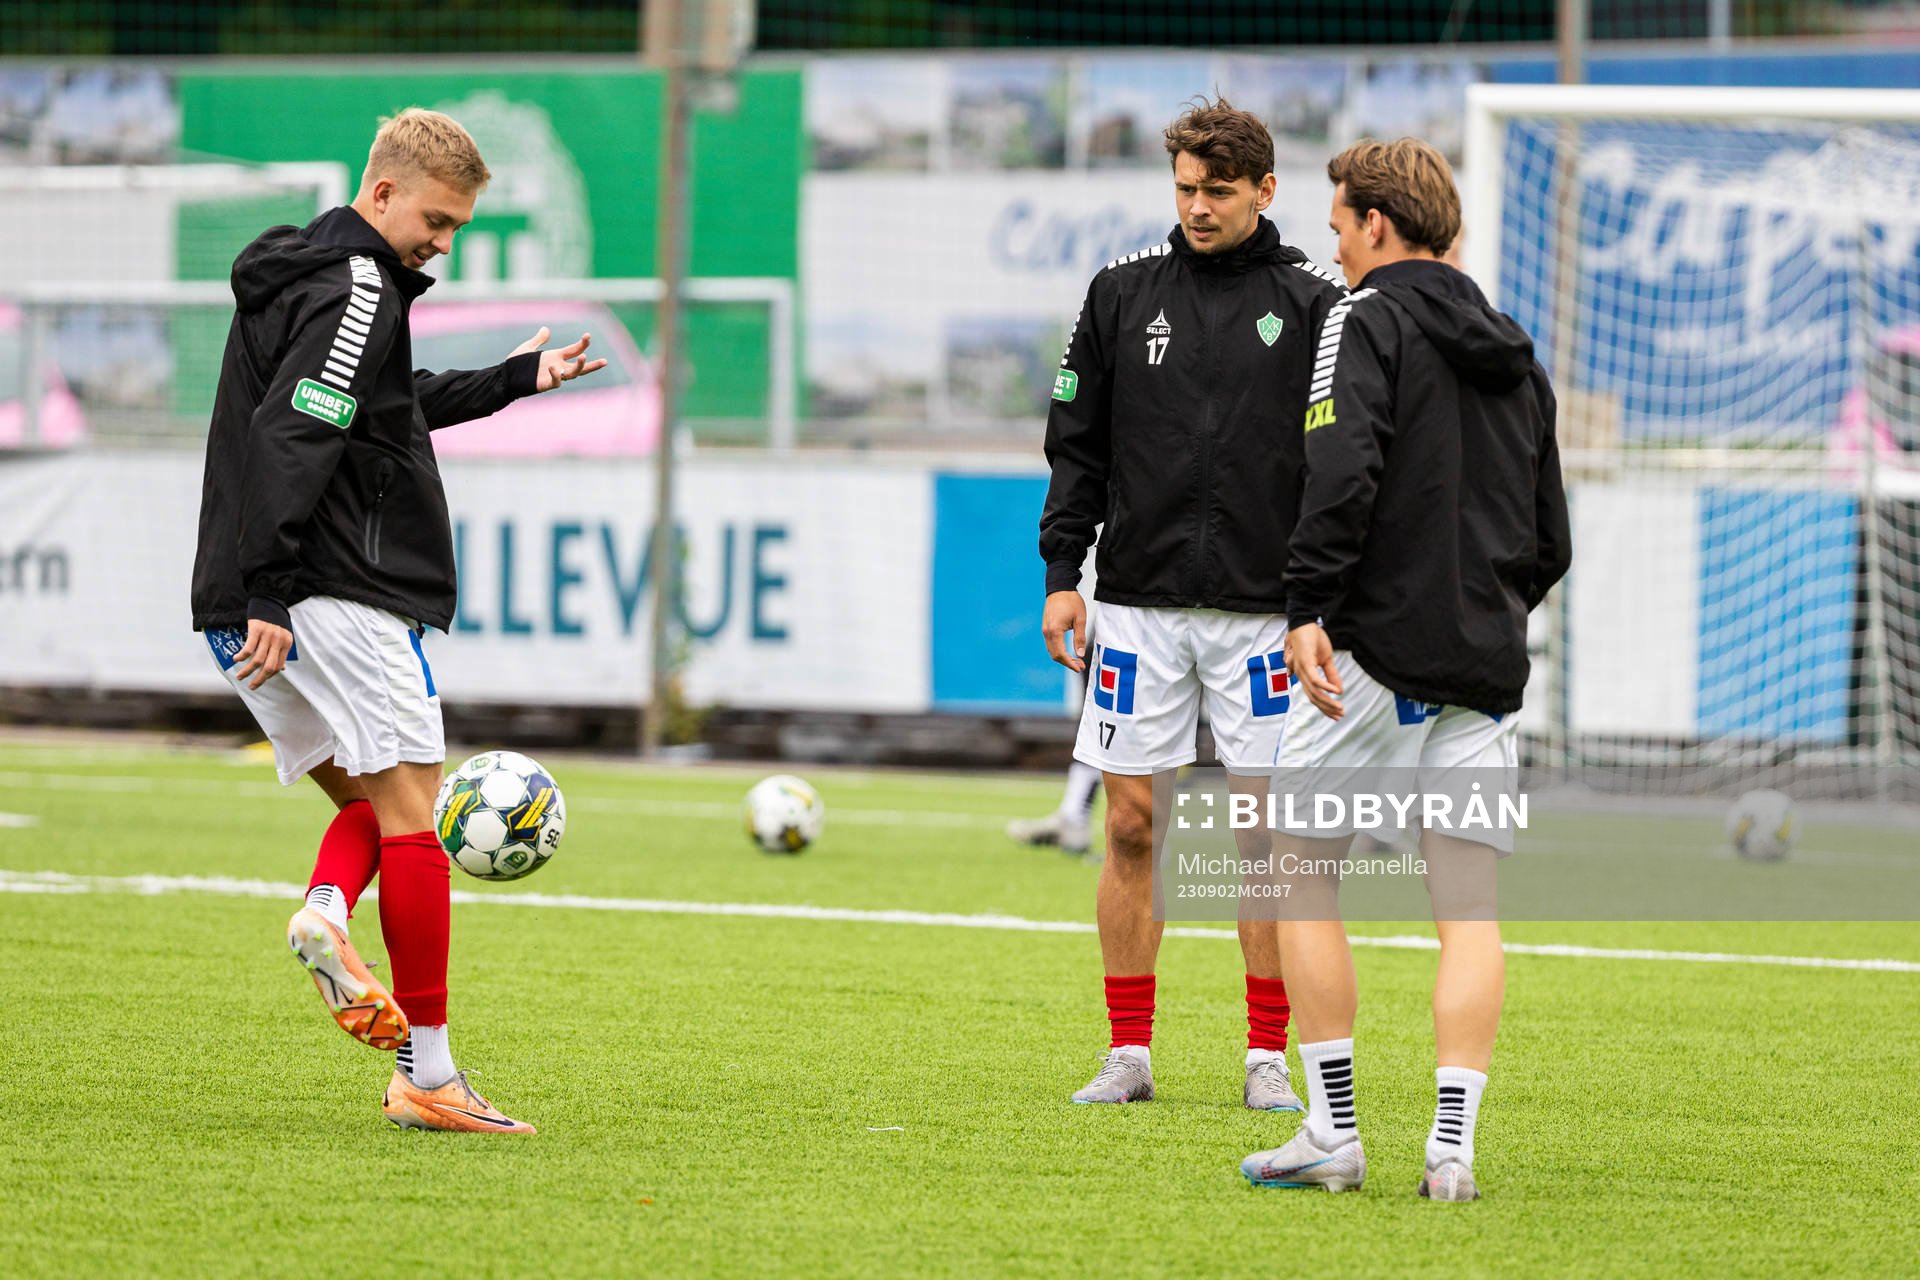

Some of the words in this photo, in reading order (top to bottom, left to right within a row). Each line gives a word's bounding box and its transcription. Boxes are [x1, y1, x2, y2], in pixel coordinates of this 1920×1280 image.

[1146, 326, 1171, 335] SELECT
[1146, 337, 1170, 365] 17
[301, 385, 353, 416] UNIBET
[438, 520, 790, 641] LLEVUE
[1099, 720, 1116, 750] 17
